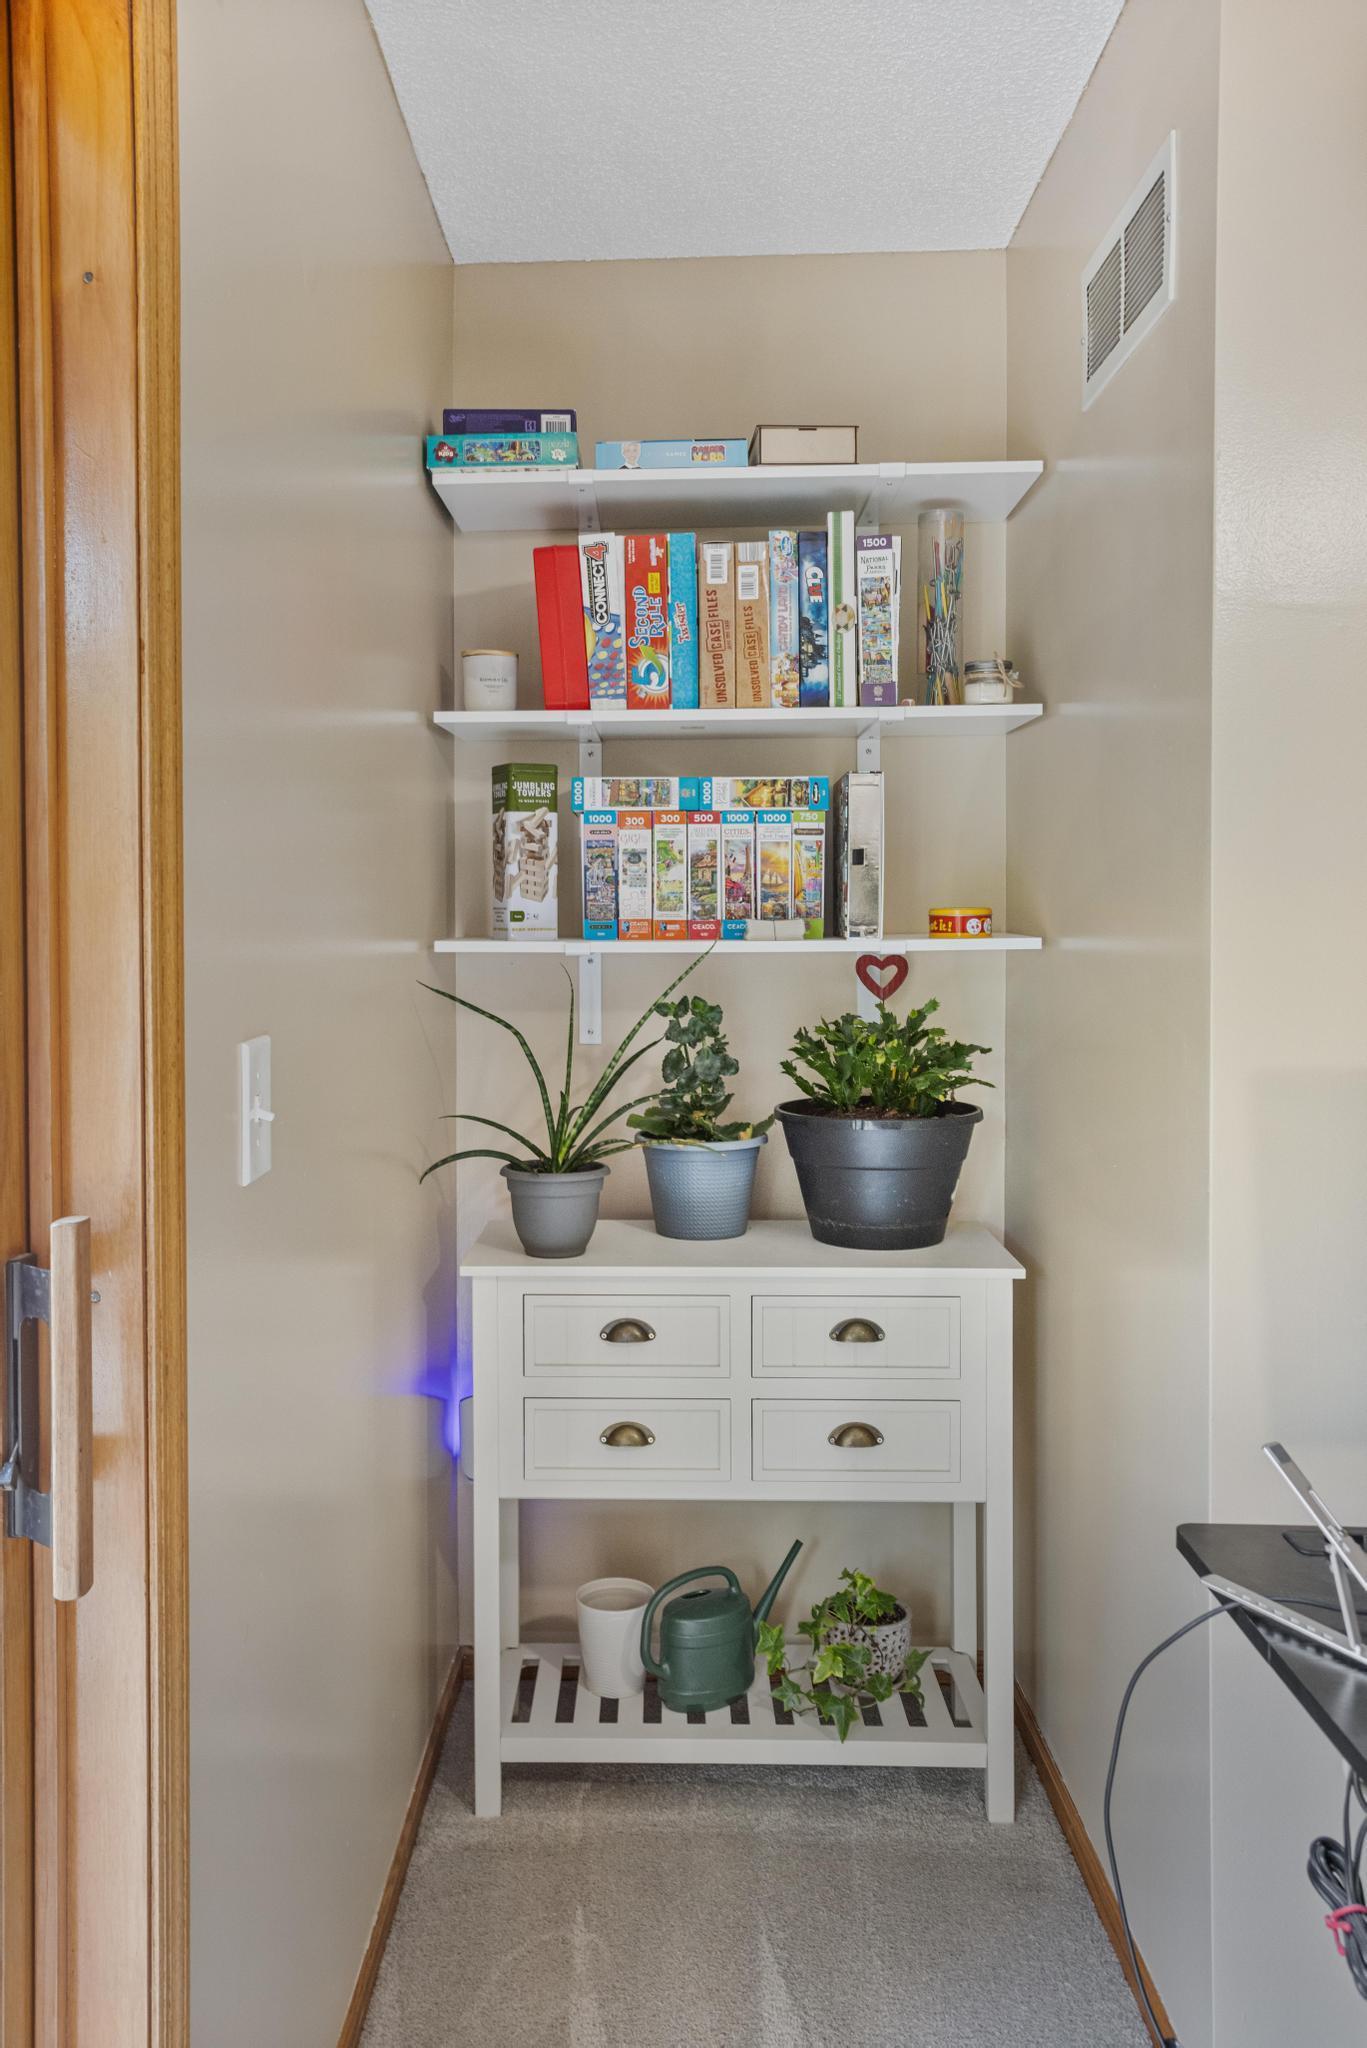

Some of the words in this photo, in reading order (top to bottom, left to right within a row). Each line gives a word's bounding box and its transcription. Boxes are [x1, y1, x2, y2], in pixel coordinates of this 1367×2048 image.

[584, 544, 607, 561] 4
[862, 537, 887, 547] 1500
[592, 560, 608, 624] CONNECT
[805, 566, 824, 603] CLUE
[706, 589, 719, 618] FILES
[629, 586, 651, 648] SECOND
[650, 597, 665, 637] RULE
[675, 602, 691, 644] Twister
[743, 605, 755, 630] FILES
[710, 621, 723, 650] CASE
[747, 632, 758, 657] CASE
[712, 653, 728, 703] UNSOLVED
[749, 660, 762, 702] UNSOLVED
[512, 781, 555, 790] JUMBLING
[517, 789, 552, 797] TOWERS
[574, 781, 582, 805] 1000
[703, 781, 711, 804] 1000
[588, 815, 612, 823] 1000
[625, 817, 645, 825] 300
[660, 814, 680, 823] 300
[694, 814, 714, 822] 500
[726, 813, 749, 822] 1000
[763, 813, 787, 822] 1000
[800, 812, 818, 820] 750
